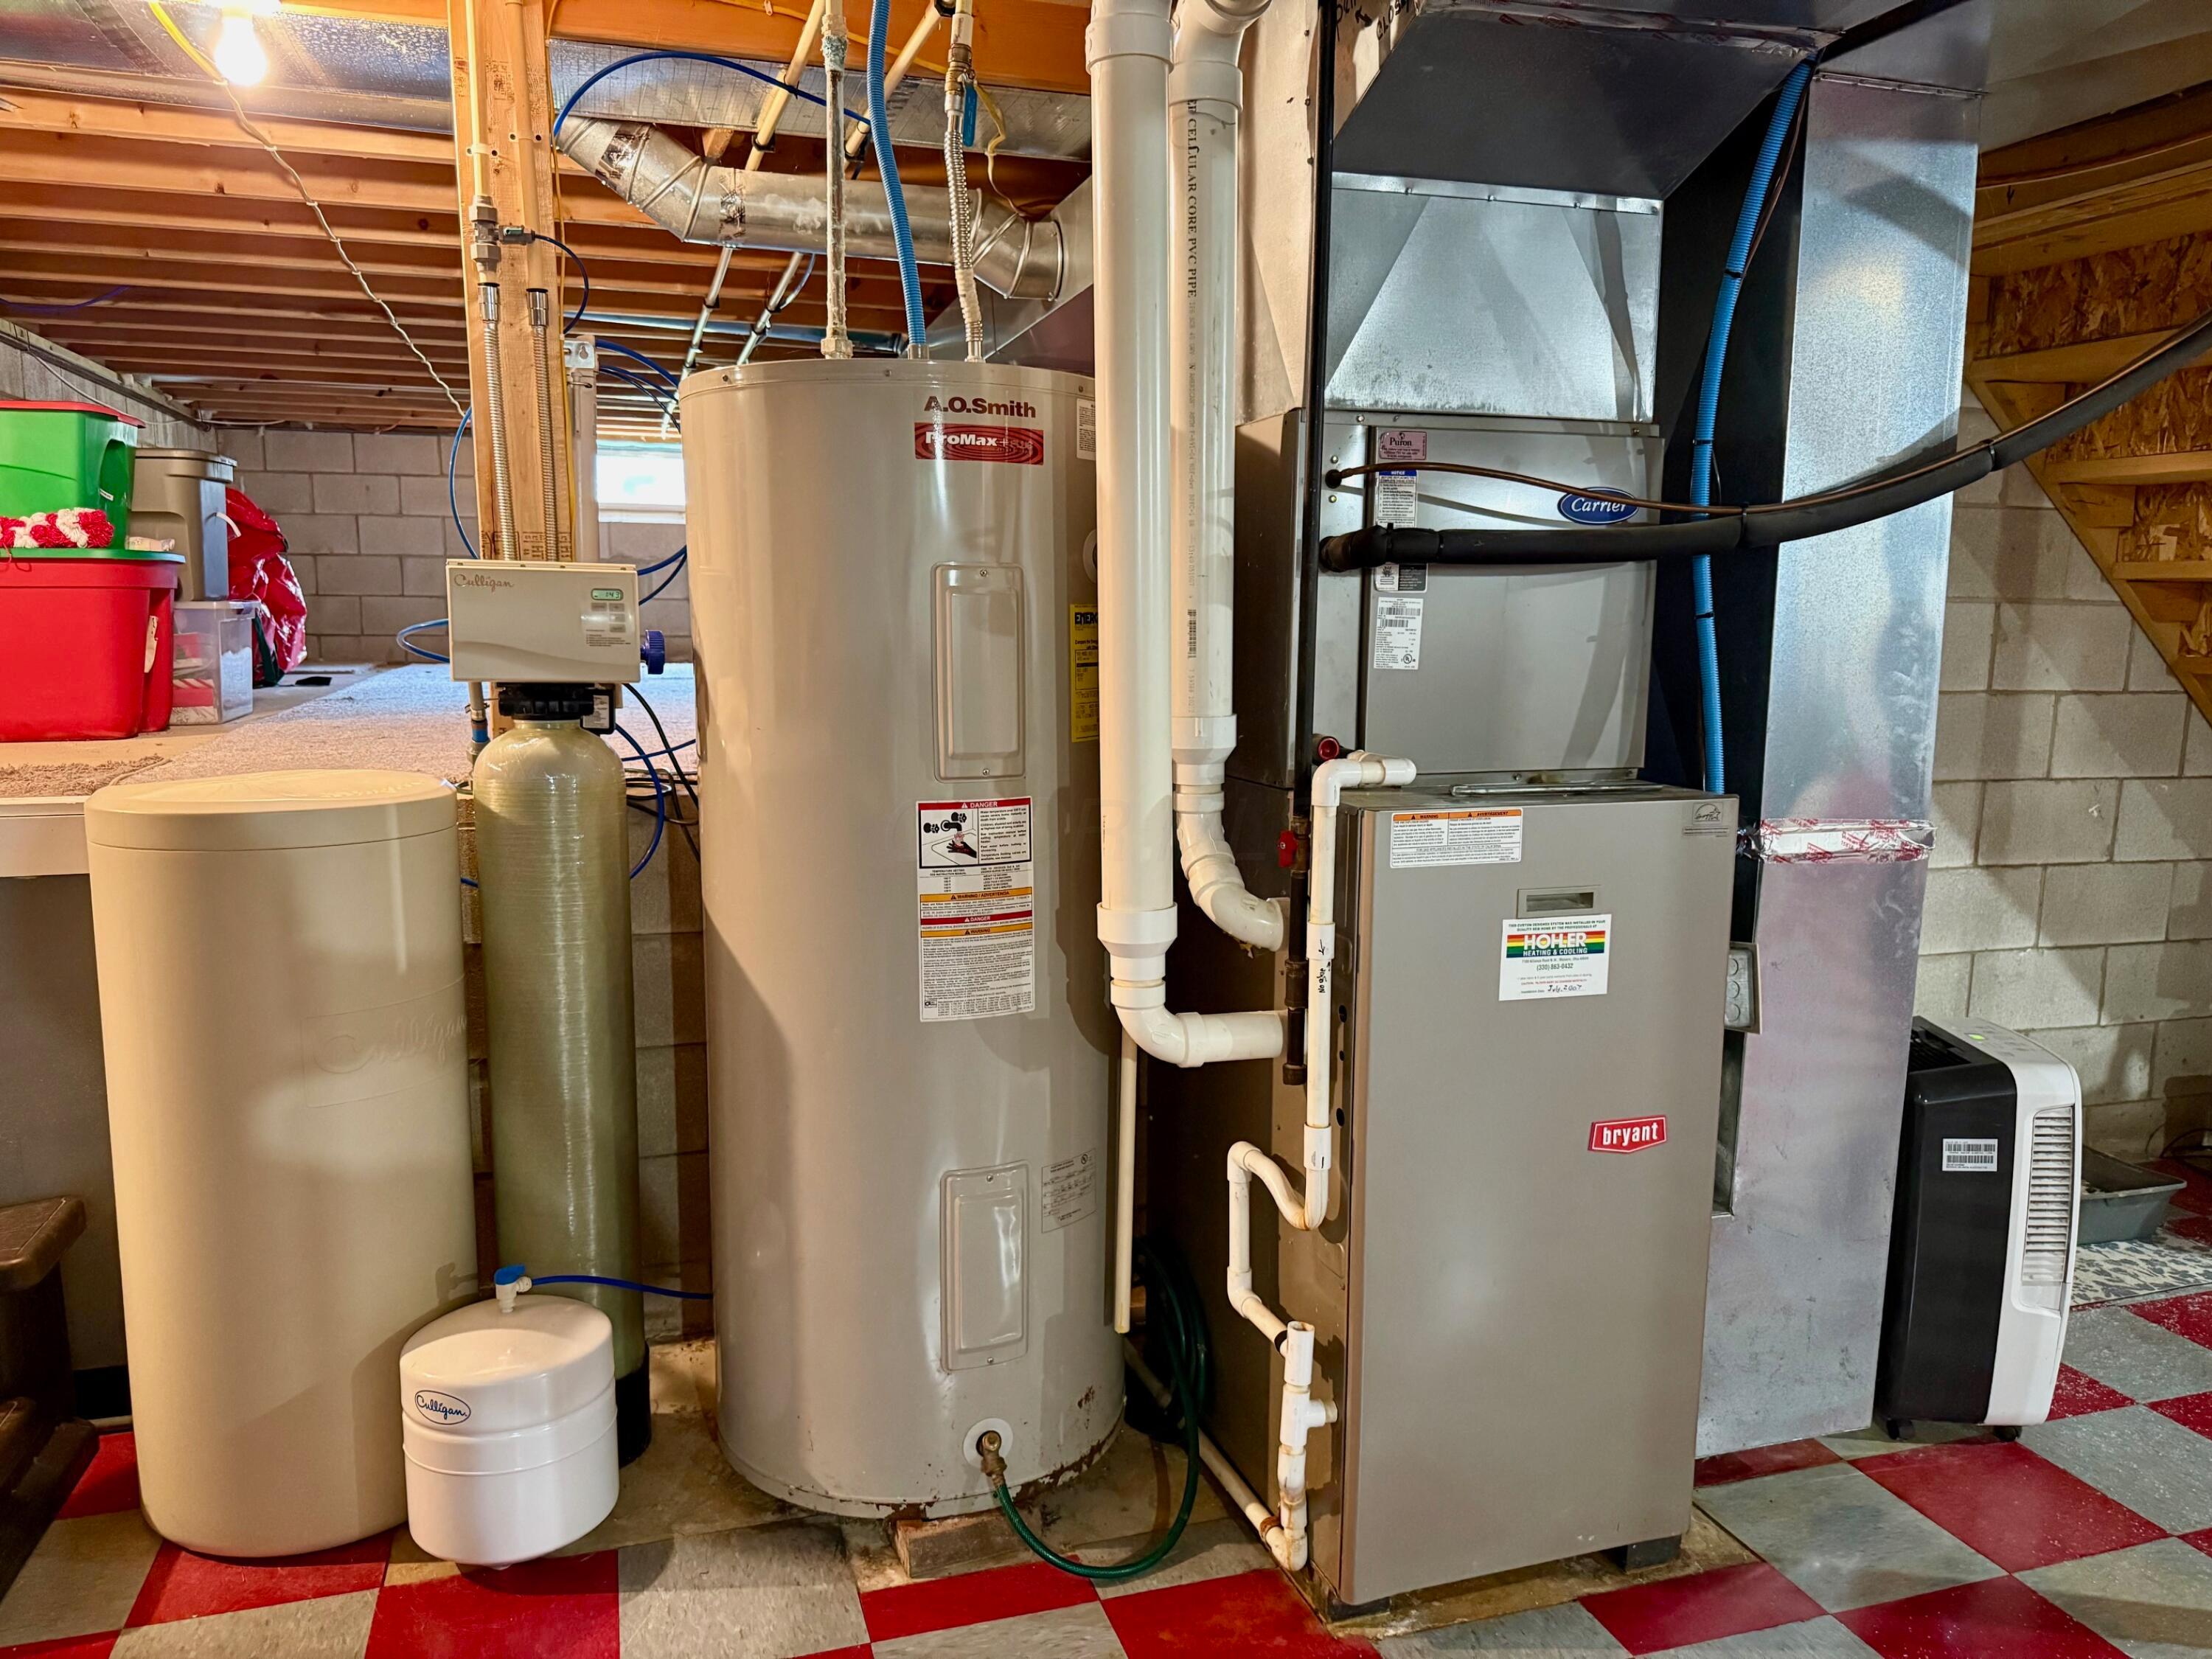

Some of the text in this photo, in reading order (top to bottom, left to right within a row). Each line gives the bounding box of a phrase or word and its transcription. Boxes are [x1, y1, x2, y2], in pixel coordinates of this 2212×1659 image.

[1188, 119, 1197, 191] CELLULAR
[1188, 196, 1197, 234] CORE
[1188, 238, 1197, 264] PVC
[1188, 268, 1197, 298] PIPE
[924, 396, 1036, 418] A.O.Smith
[1390, 437, 1412, 446] Puron
[1571, 497, 1626, 512] Carrier
[453, 574, 515, 593] Culligan
[1523, 932, 1587, 950] HOHLER
[1602, 1122, 1658, 1147] bryant
[417, 1394, 466, 1420] Culligan
